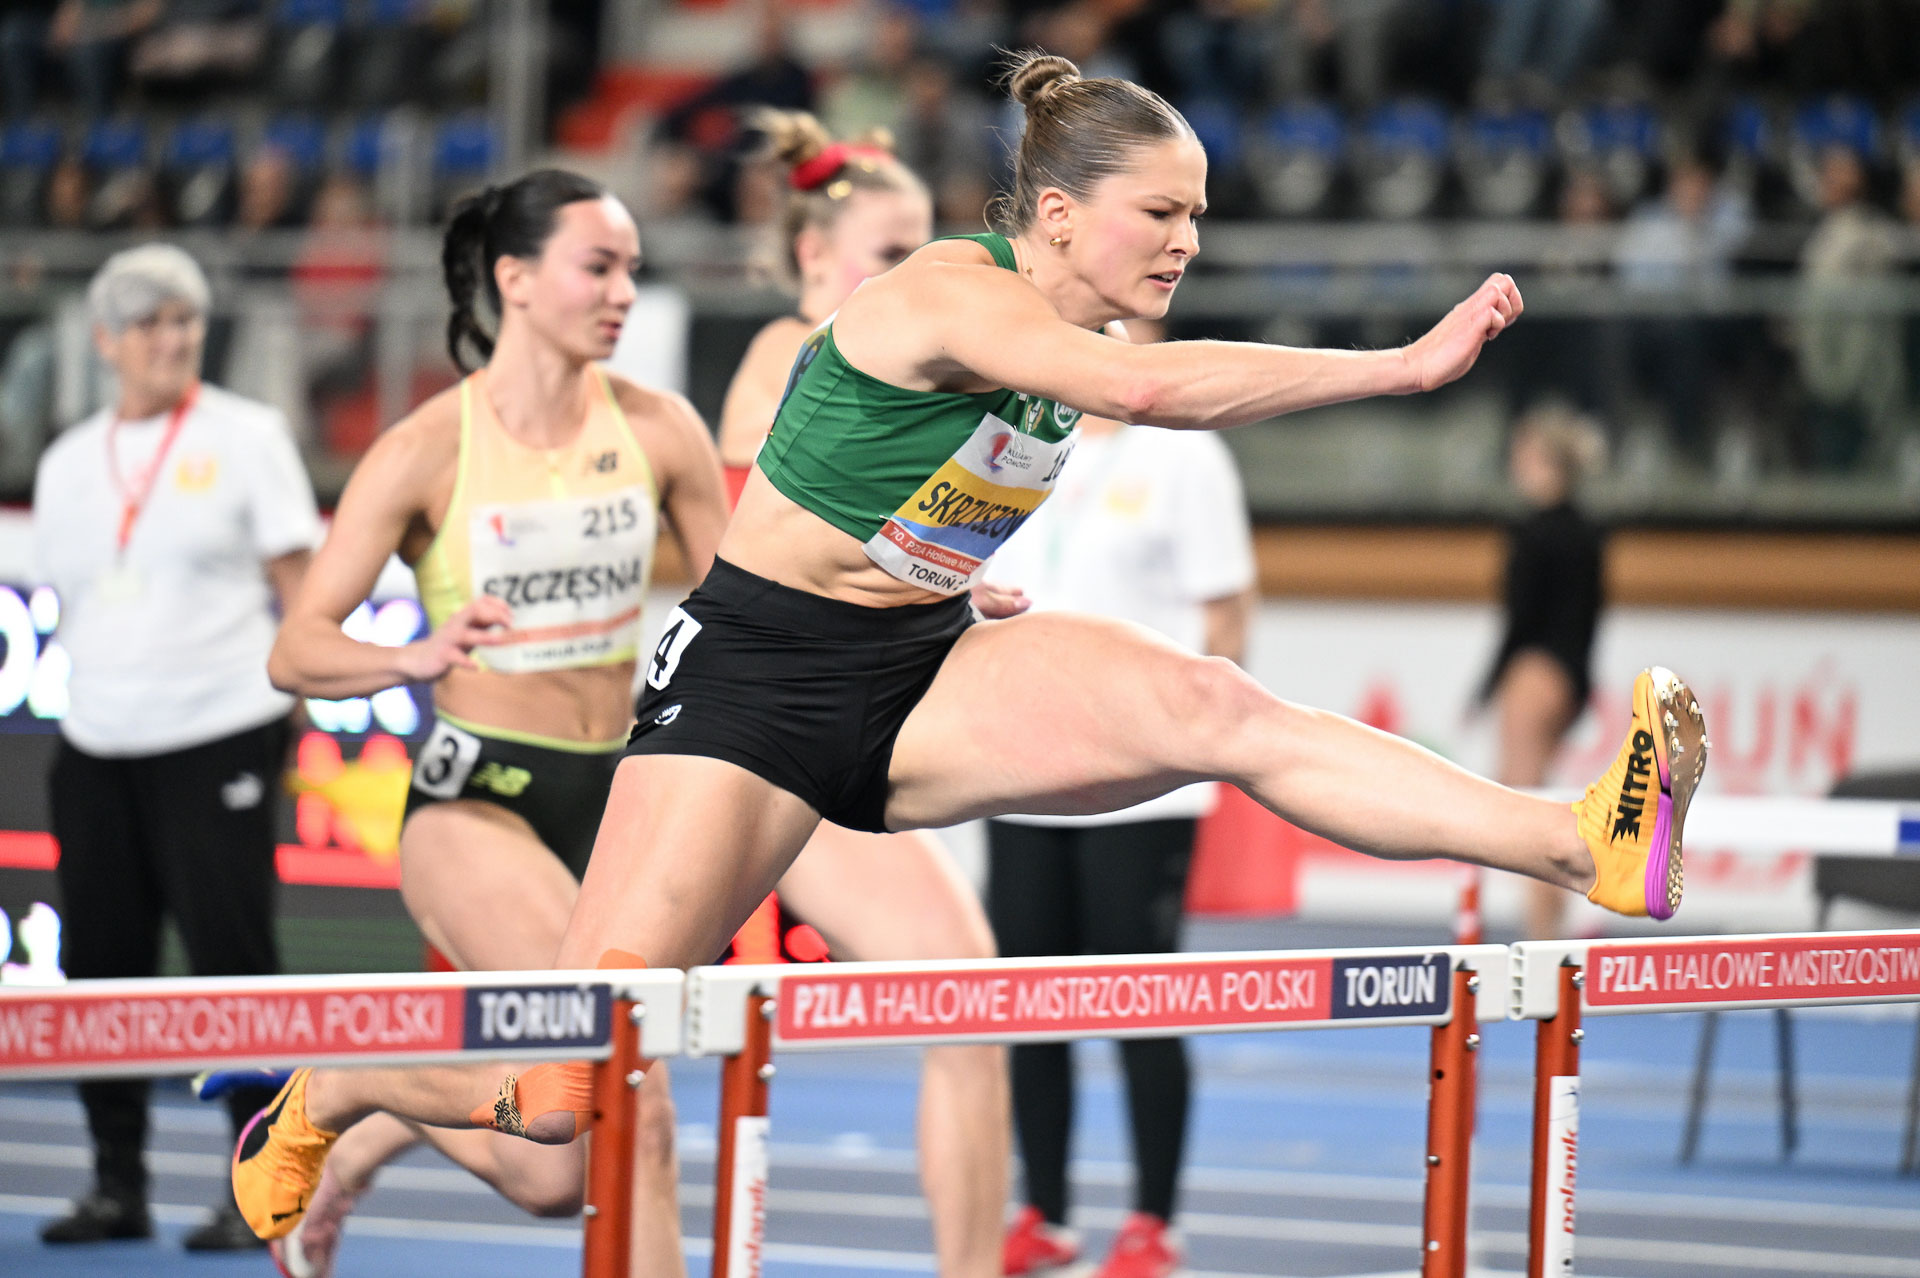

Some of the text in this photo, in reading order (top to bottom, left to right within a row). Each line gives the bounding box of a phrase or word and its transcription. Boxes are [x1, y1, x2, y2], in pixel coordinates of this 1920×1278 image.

[583, 499, 638, 538] 215
[890, 526, 905, 545] 70.
[905, 540, 927, 557] PZLA
[926, 547, 958, 566] Halowe
[483, 557, 642, 610] SZCZĘSNA
[908, 563, 957, 590] TORUŃ
[654, 619, 685, 682] 4
[423, 735, 459, 786] 3
[1609, 729, 1653, 846] NITRO
[792, 953, 1437, 1029] PZLA HALOWE MISTRZOSTWA POLSKI TORUŃ
[1599, 955, 1660, 993] PZLA
[1664, 951, 1774, 991] HALOWE
[60, 995, 316, 1056] MISTRZOSTWA
[322, 992, 445, 1046] POLSKI
[478, 982, 597, 1041] TORUŃ
[1559, 1128, 1577, 1235] polanik
